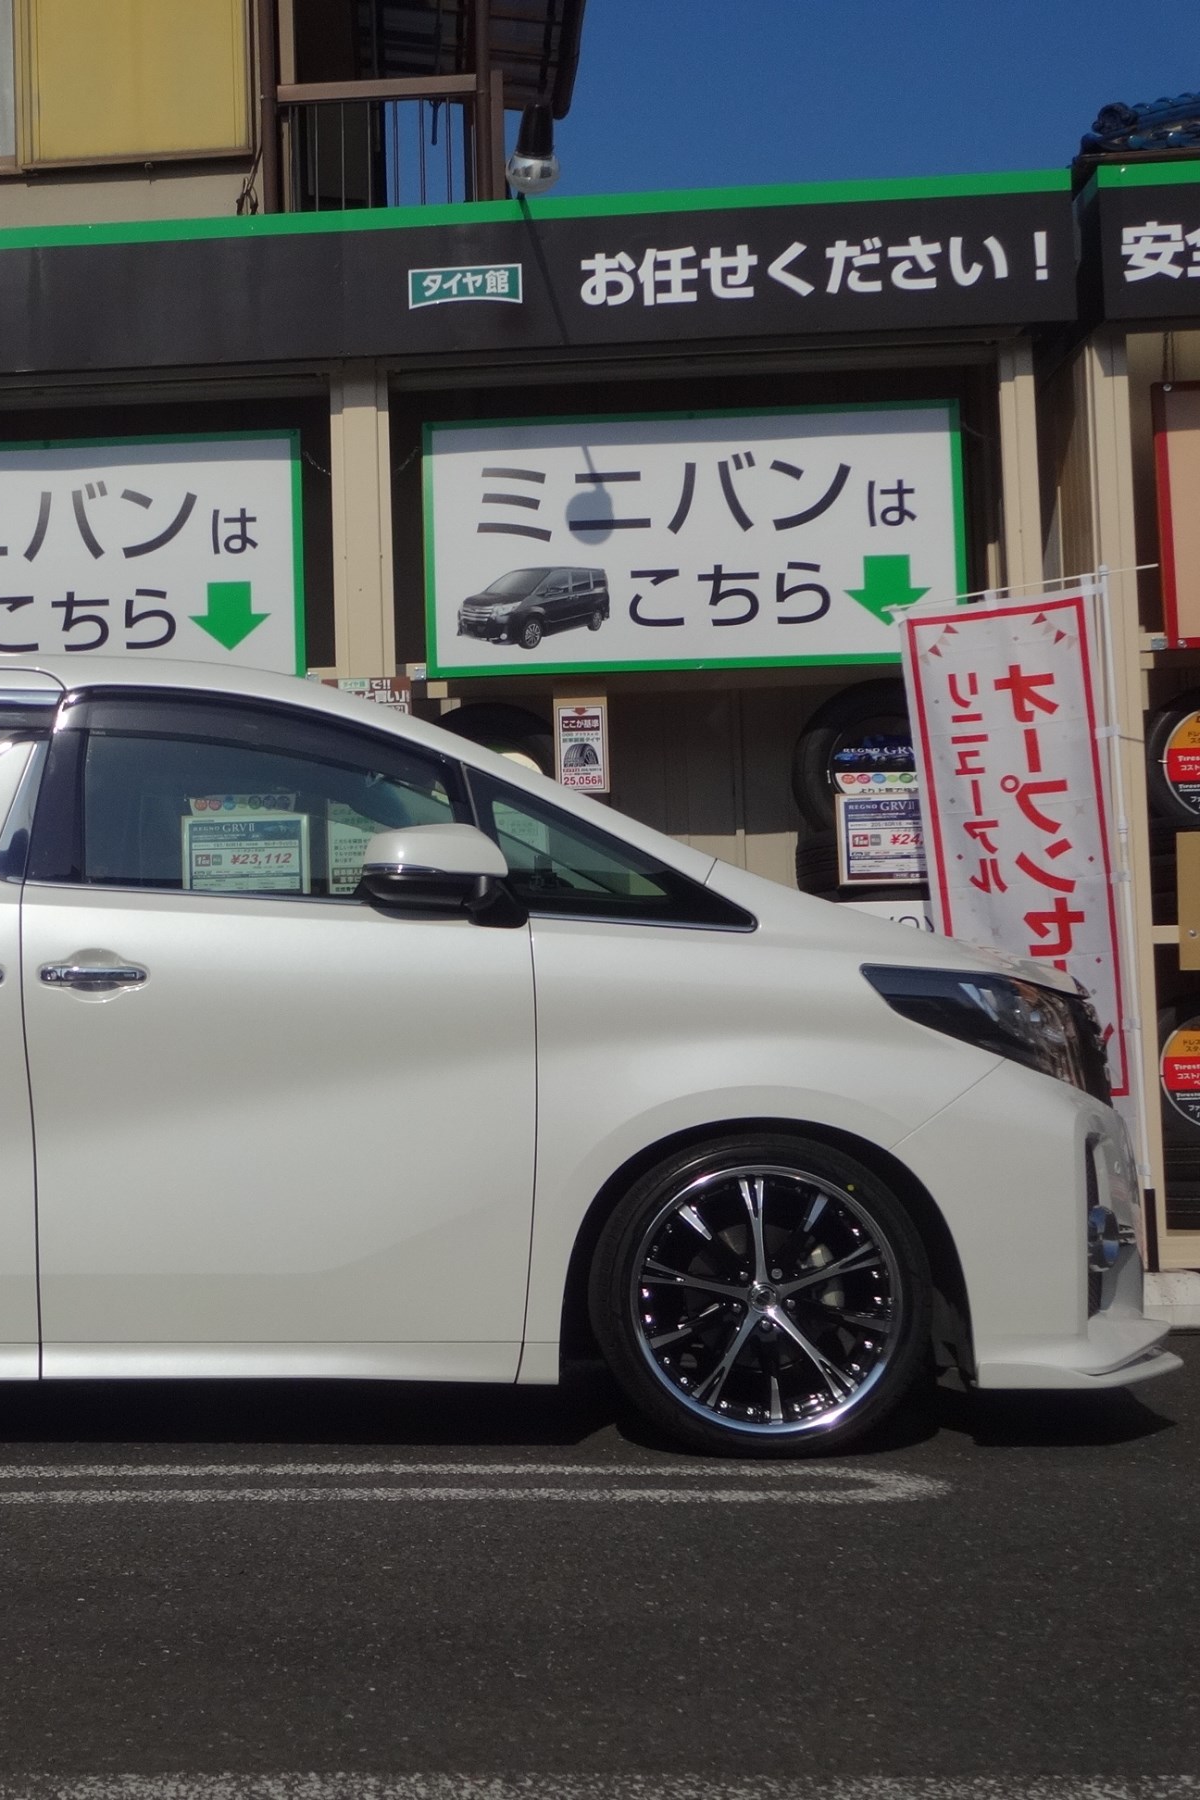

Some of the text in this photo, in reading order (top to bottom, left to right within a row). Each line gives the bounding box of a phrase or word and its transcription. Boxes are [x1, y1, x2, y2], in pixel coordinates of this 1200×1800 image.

[422, 267, 510, 298] タイヤ館
[581, 230, 1049, 306] お任せください！
[477, 450, 917, 542] ミニバンは
[628, 561, 830, 627] こちら
[230, 852, 293, 866] ¥23,112
